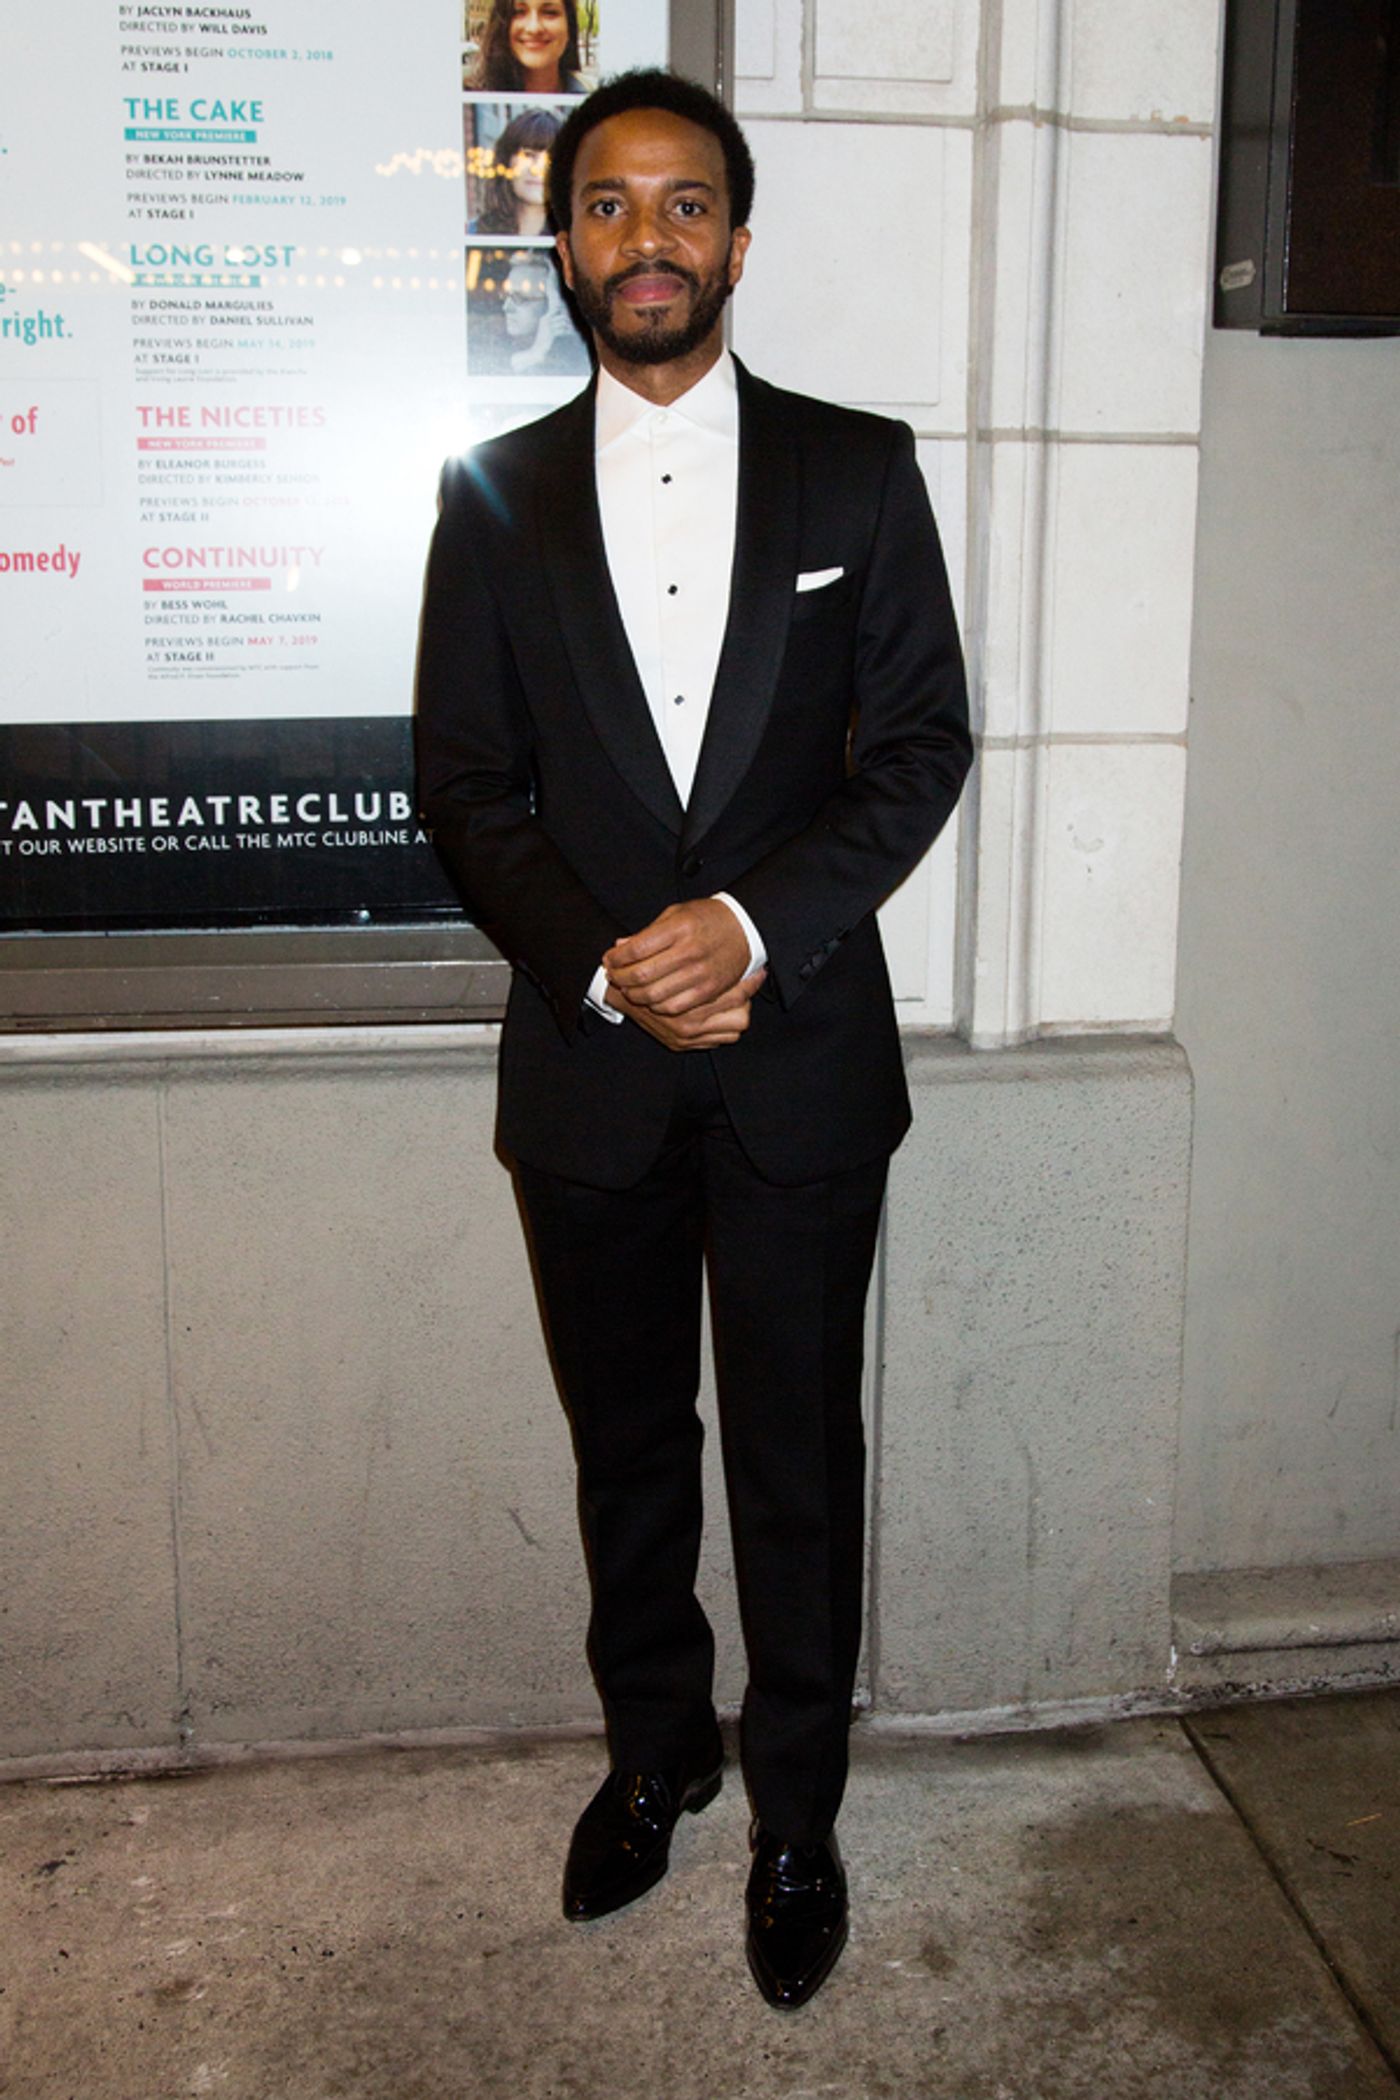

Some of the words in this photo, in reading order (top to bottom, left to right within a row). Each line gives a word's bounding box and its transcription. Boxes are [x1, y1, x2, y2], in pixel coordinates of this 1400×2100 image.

[119, 5, 133, 16] BY
[137, 6, 182, 17] JACLYN
[186, 7, 251, 19] BACKHAUS
[120, 21, 177, 32] DIRECTED
[181, 23, 195, 33] BY
[199, 23, 228, 34] WILL
[232, 24, 267, 35] DAVIS
[121, 46, 181, 57] PREVIEWS
[185, 47, 223, 58] BEGIN
[227, 48, 287, 60] OCTOBER
[292, 49, 302, 60] 2,
[306, 50, 333, 61] 2018
[122, 62, 135, 72] AT
[141, 63, 179, 72] STAGE
[124, 98, 180, 120] THE
[190, 99, 265, 123] CAKE
[136, 130, 160, 141] NEW
[164, 130, 192, 141] YORK
[196, 131, 246, 142] PREMIERE
[126, 154, 140, 164] BY
[144, 154, 183, 165] BEKAH
[187, 155, 271, 166] BRUNSTETTER
[126, 170, 183, 181] DIRECTED
[186, 171, 201, 181] BY
[205, 171, 243, 181] LYNNE
[248, 171, 304, 182] MEADOW
[127, 194, 187, 204] PREVIEWS
[191, 194, 229, 205] BEGIN
[233, 195, 295, 206] FEBRUARY
[300, 195, 316, 206] 12,
[128, 210, 143, 219] AT
[147, 210, 186, 219] STAGE
[131, 245, 214, 266] LONG
[131, 300, 146, 310] BY
[150, 300, 201, 311] DONALD
[205, 301, 274, 312] MARGULIES
[132, 316, 188, 326] DIRECTED
[191, 316, 206, 326] BY
[210, 316, 252, 326] DANIEL
[256, 316, 313, 326] SULLIVAN
[133, 339, 192, 349] PREVIEWS
[196, 339, 234, 349] BEGIN
[238, 339, 263, 349] MAY
[135, 354, 149, 363] AT
[152, 354, 191, 363] STAGE
[11, 406, 38, 434] of
[136, 406, 191, 426] THE
[201, 406, 326, 426] NICETIES
[148, 439, 172, 448] NEW
[176, 439, 201, 448] YORK
[138, 459, 153, 469] BY
[156, 459, 210, 469] ELEANOR
[214, 459, 265, 469] BURGESS
[138, 474, 194, 484] DIRECTED
[198, 474, 213, 484] BY
[216, 474, 271, 484] KIMBERLY
[140, 497, 199, 507] PREVIEWS
[202, 496, 239, 507] BEGIN
[140, 512, 155, 522] AT
[159, 512, 197, 522] STAGE
[143, 546, 326, 568] CONTINUITY
[163, 580, 200, 590] WORLD
[203, 580, 252, 589] PREMIERE
[144, 601, 157, 610] BY
[161, 601, 189, 610] BESS
[191, 600, 228, 610] WOHL
[145, 614, 199, 625] DIRECTED
[203, 614, 217, 624] BY
[220, 613, 265, 624] RACHEL
[269, 613, 321, 623] CHAVKIN
[145, 636, 204, 647] PREVIEWS
[207, 636, 244, 646] BEGIN
[247, 636, 274, 646] MAY
[280, 636, 289, 646] 7,
[291, 635, 318, 646] 2019
[147, 652, 161, 662] AT
[164, 652, 202, 661] STAGE
[19, 839, 62, 855] OUR
[67, 837, 145, 854] WEBSITE
[151, 836, 180, 851] OR
[185, 835, 231, 851] CALL
[236, 834, 271, 849] THE
[278, 833, 316, 848] MTC
[322, 830, 409, 847] CLUBLINE
